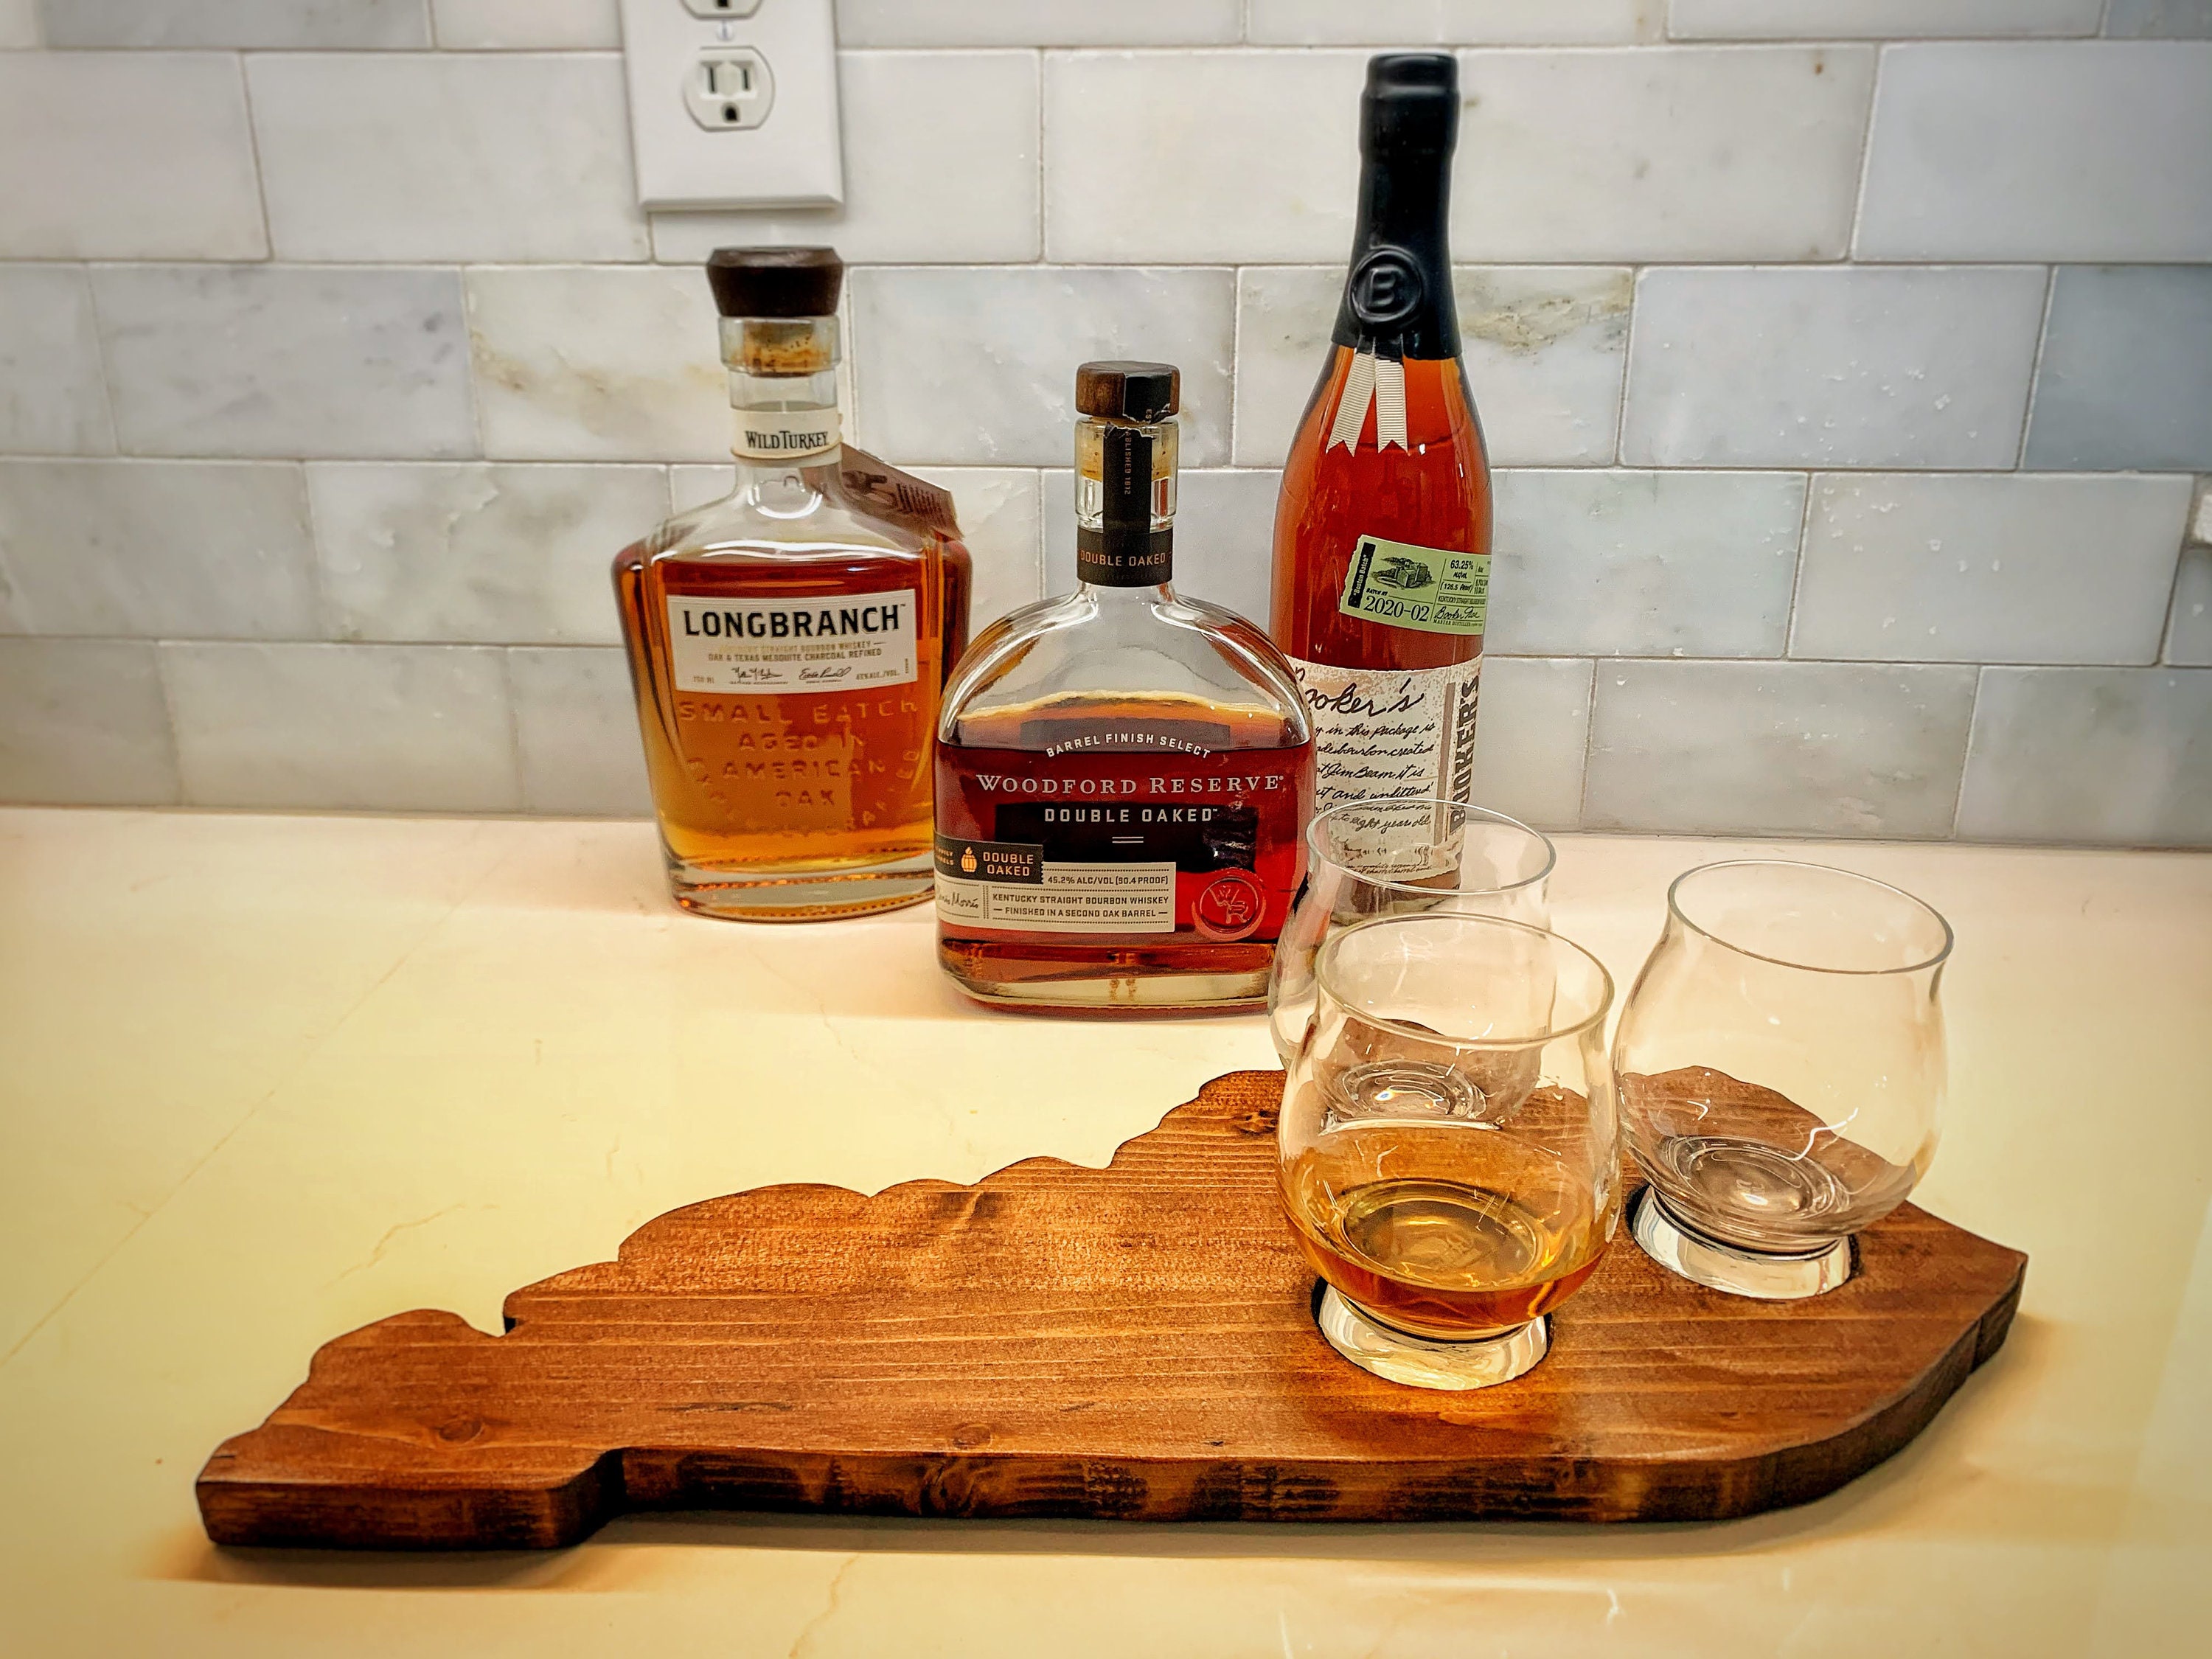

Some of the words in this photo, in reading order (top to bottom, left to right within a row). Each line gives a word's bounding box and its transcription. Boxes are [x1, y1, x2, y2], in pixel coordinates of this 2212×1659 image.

[1080, 549, 1122, 566] DOUBLE
[1129, 552, 1166, 566] OAKED
[1450, 560, 1473, 570] 63.25%
[1363, 595, 1430, 622] 2020-02
[684, 604, 899, 638] LONGBRANCH
[734, 653, 760, 662] TEXAS
[762, 653, 803, 662] MESQUITE
[805, 652, 846, 661] CHARCOAL
[849, 649, 882, 658] REFINED
[1345, 723, 1370, 737] this
[1369, 723, 1419, 740] package
[1046, 735, 1101, 757] BARREL
[1105, 733, 1154, 744] FINISH
[1159, 736, 1211, 759] SELECT
[1387, 740, 1434, 757] created
[975, 774, 1137, 794] WOODFORD
[1149, 775, 1279, 793] RESERVE
[1332, 789, 1366, 800] and
[1045, 808, 1130, 823] DOUBLE
[1141, 808, 1211, 823] OAKED
[983, 852, 1034, 864] DOUBLE
[987, 864, 1030, 876] OAKED
[1047, 876, 1075, 884] 45.2%
[1077, 876, 1114, 884] ALC/VOL
[1116, 876, 1137, 885] (90.4
[1138, 876, 1169, 885] PROOF)
[992, 894, 1037, 903] KENTUCKY
[1040, 896, 1083, 904] STRAIGHT
[1085, 897, 1127, 905] BOURBON
[1130, 896, 1169, 904] WHISKEY
[1005, 906, 1044, 916] FINISHED
[1047, 908, 1057, 917] IN
[1057, 908, 1064, 917] A
[1065, 909, 1100, 917] SECOND
[1121, 909, 1156, 917] BARREL
